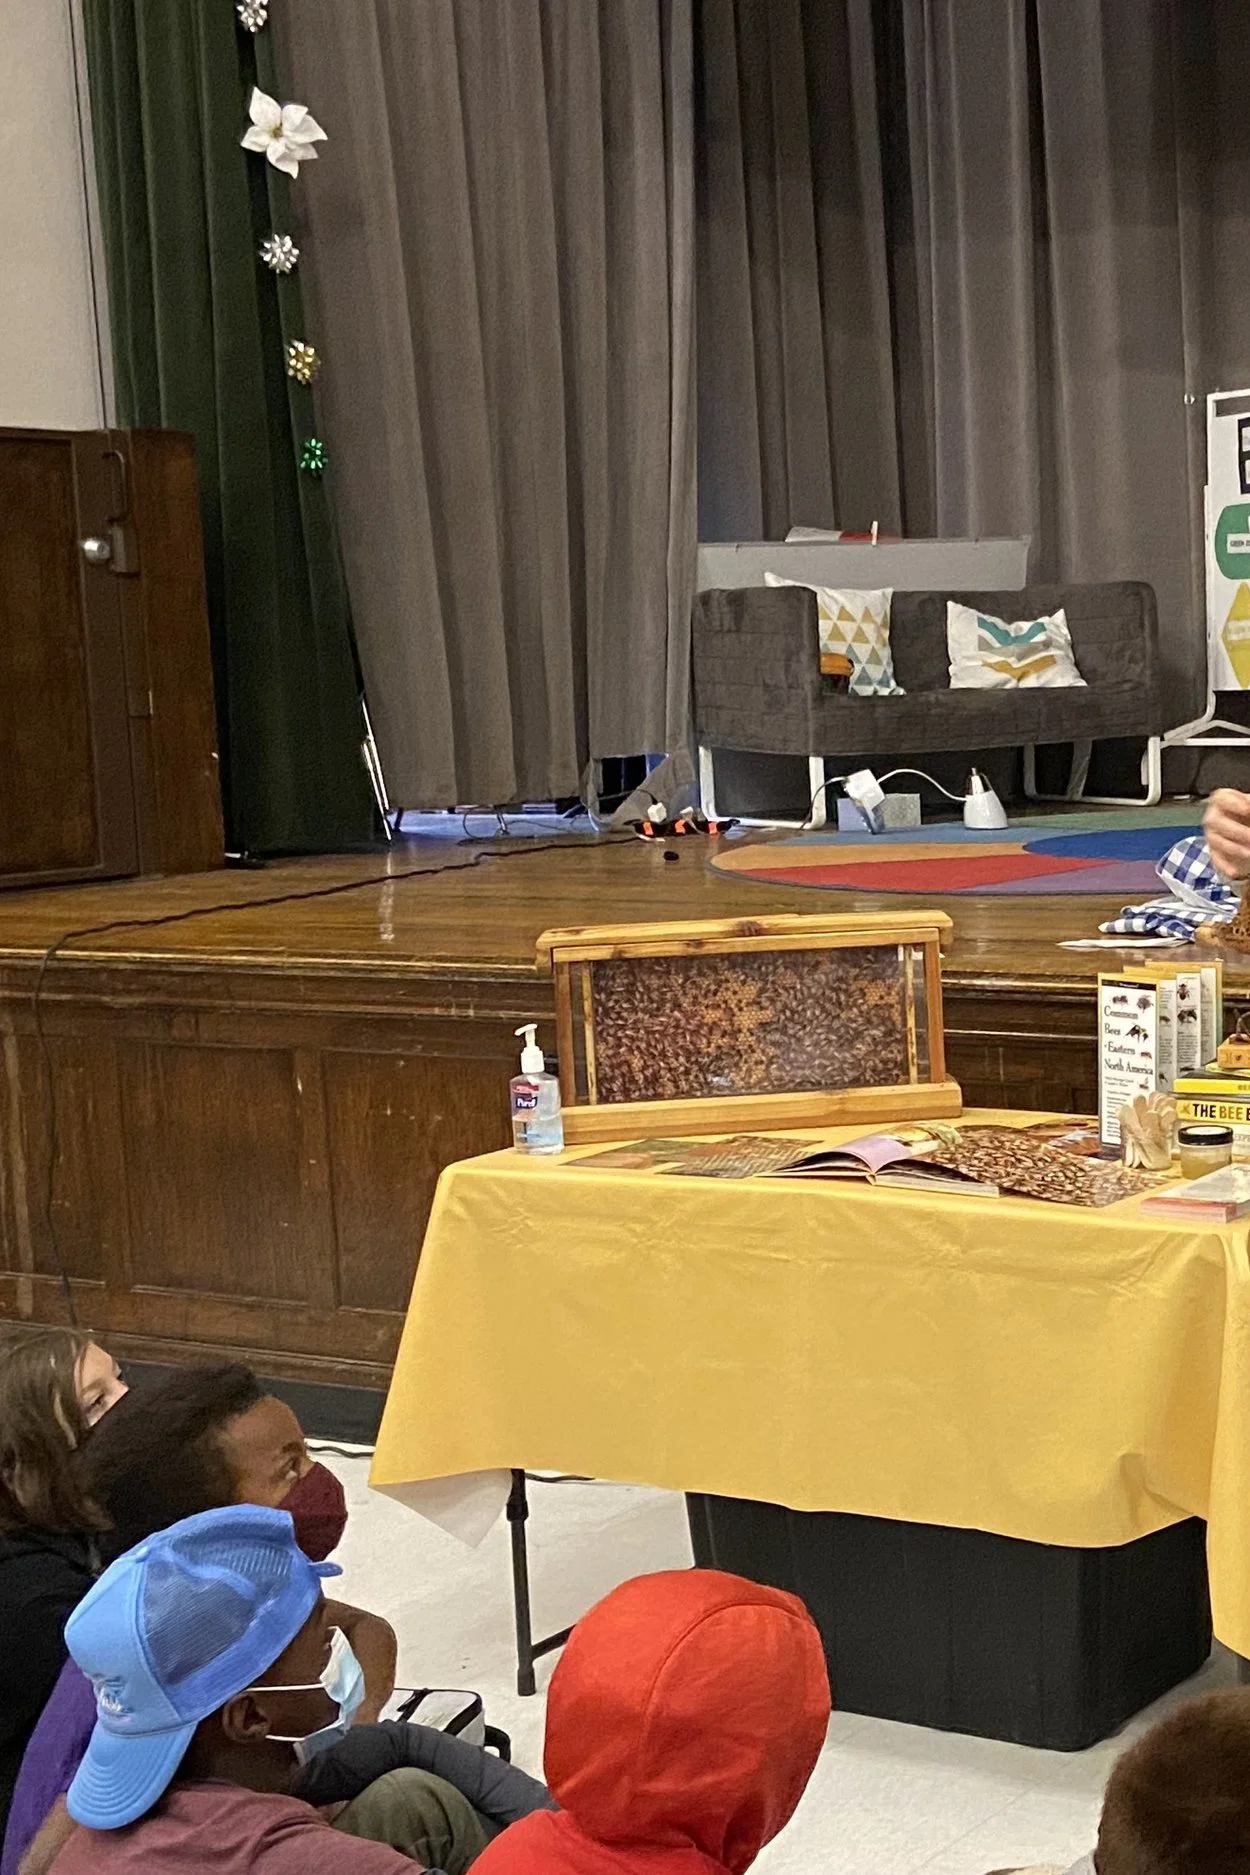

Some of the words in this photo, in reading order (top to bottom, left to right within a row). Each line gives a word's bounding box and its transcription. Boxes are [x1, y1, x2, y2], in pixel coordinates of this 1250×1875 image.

[1104, 1005, 1139, 1020] Common
[1104, 1022, 1121, 1035] Bees
[1107, 1041, 1136, 1055] Eastern
[1104, 1058, 1124, 1072] North
[1125, 1061, 1154, 1075] America
[1192, 1103, 1217, 1118] THE
[1219, 1105, 1243, 1120] BEE
